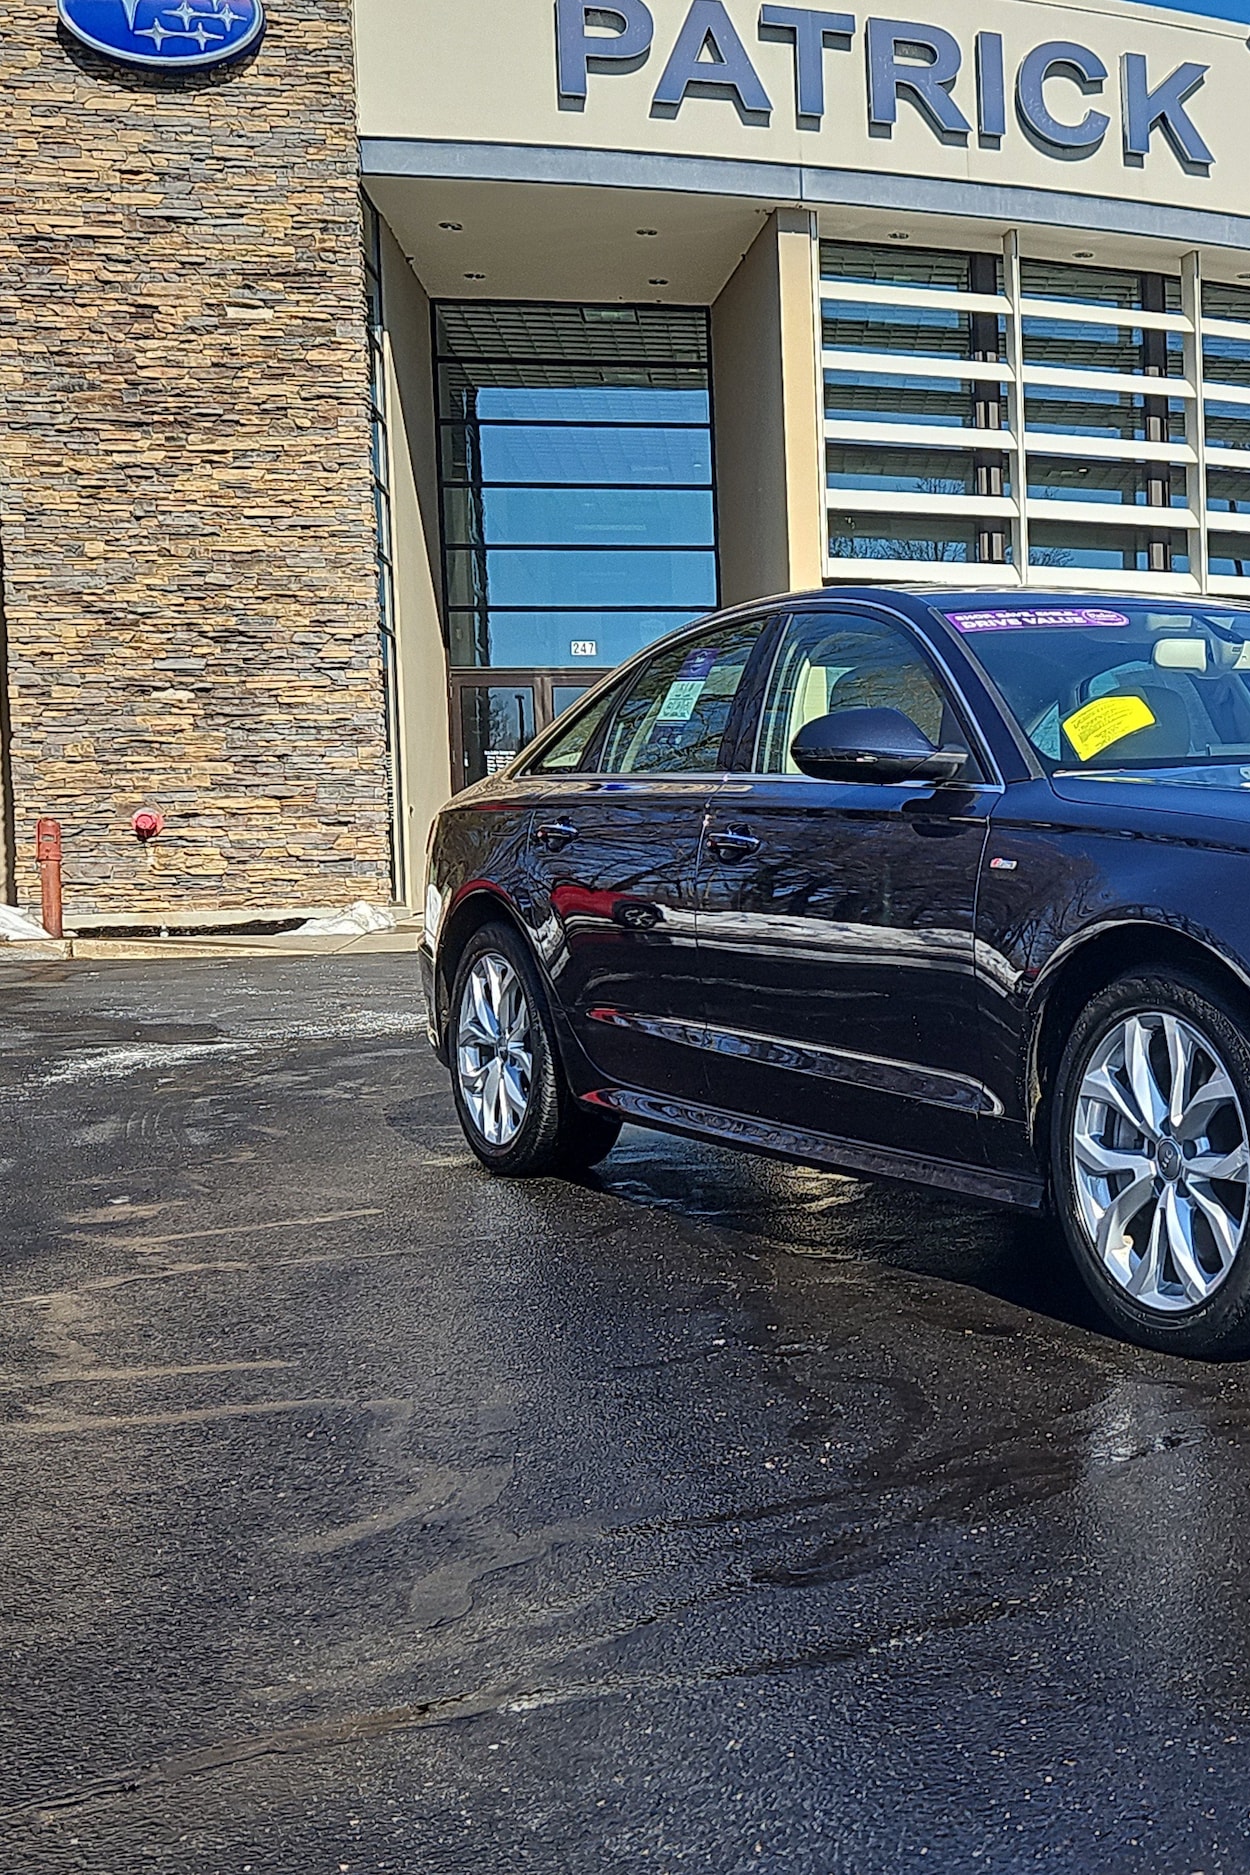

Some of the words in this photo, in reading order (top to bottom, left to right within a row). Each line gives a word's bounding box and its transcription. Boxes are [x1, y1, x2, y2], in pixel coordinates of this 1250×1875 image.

[555, 0, 1216, 170] PATRICK
[961, 618, 1022, 629] DRIVE
[1022, 616, 1087, 626] VALUE
[573, 643, 594, 654] 247
